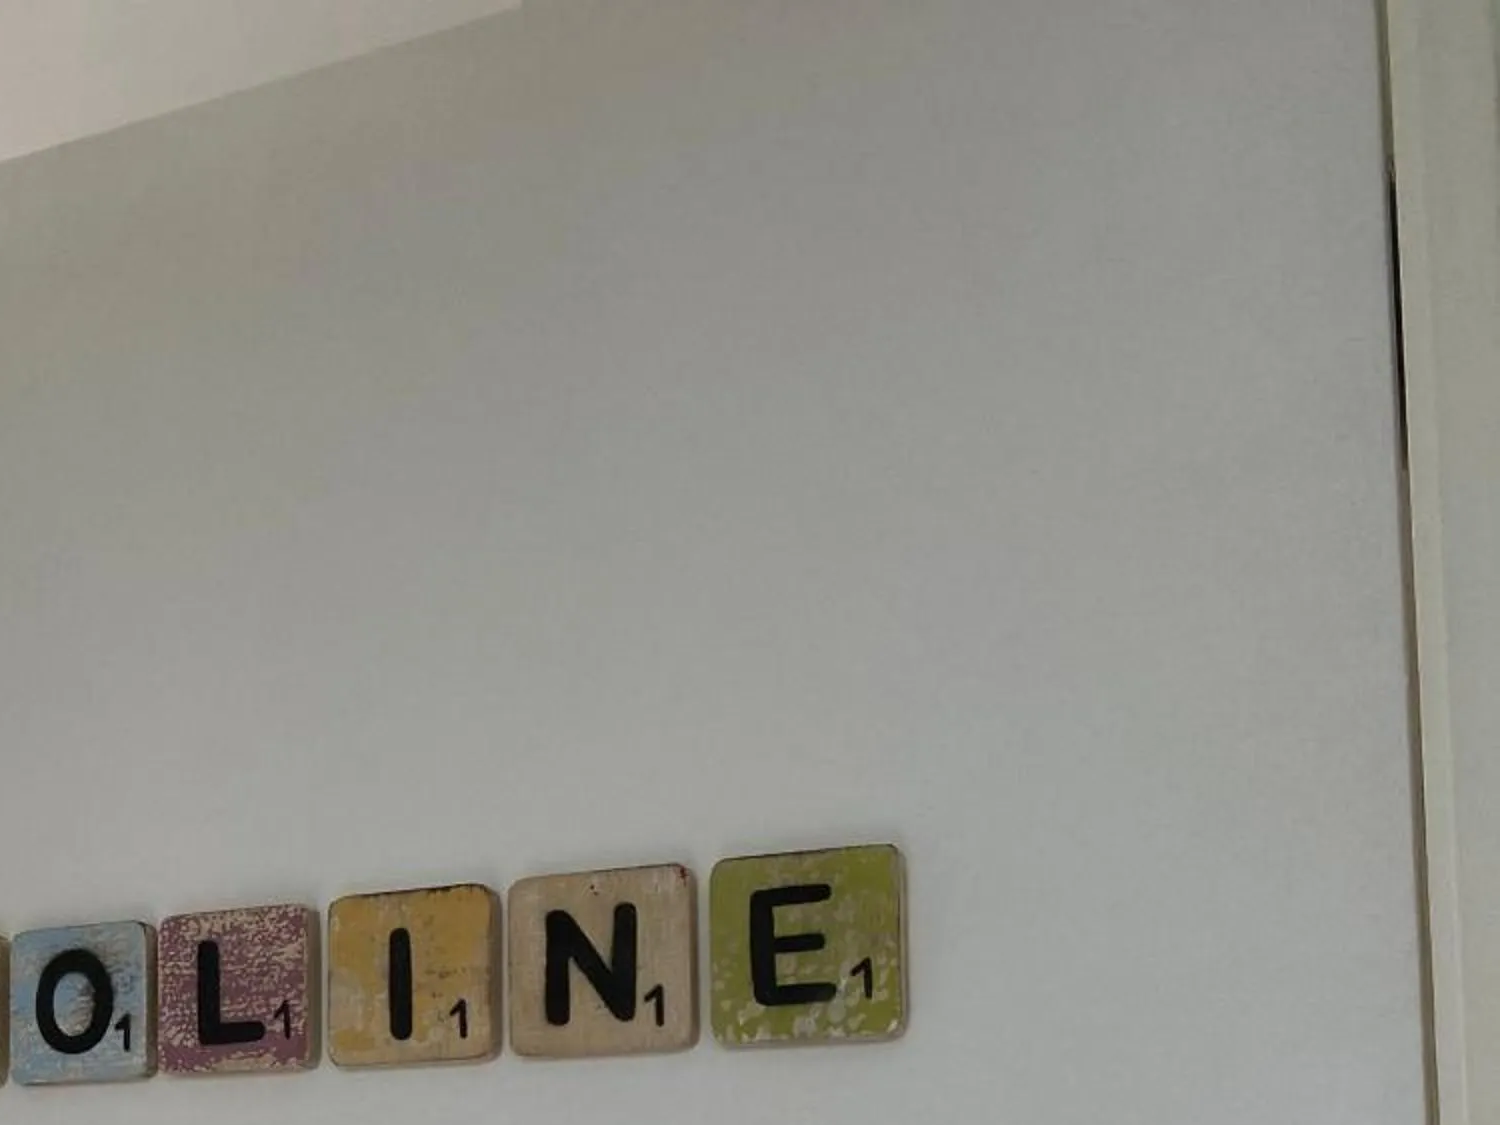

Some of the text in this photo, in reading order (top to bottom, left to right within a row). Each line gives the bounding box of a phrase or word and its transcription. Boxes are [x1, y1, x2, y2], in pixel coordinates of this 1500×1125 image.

[849, 957, 873, 998] 1
[272, 1002, 292, 1040] 1
[448, 999, 468, 1039] 1
[643, 984, 665, 1026] 1
[114, 1013, 131, 1050] 1
